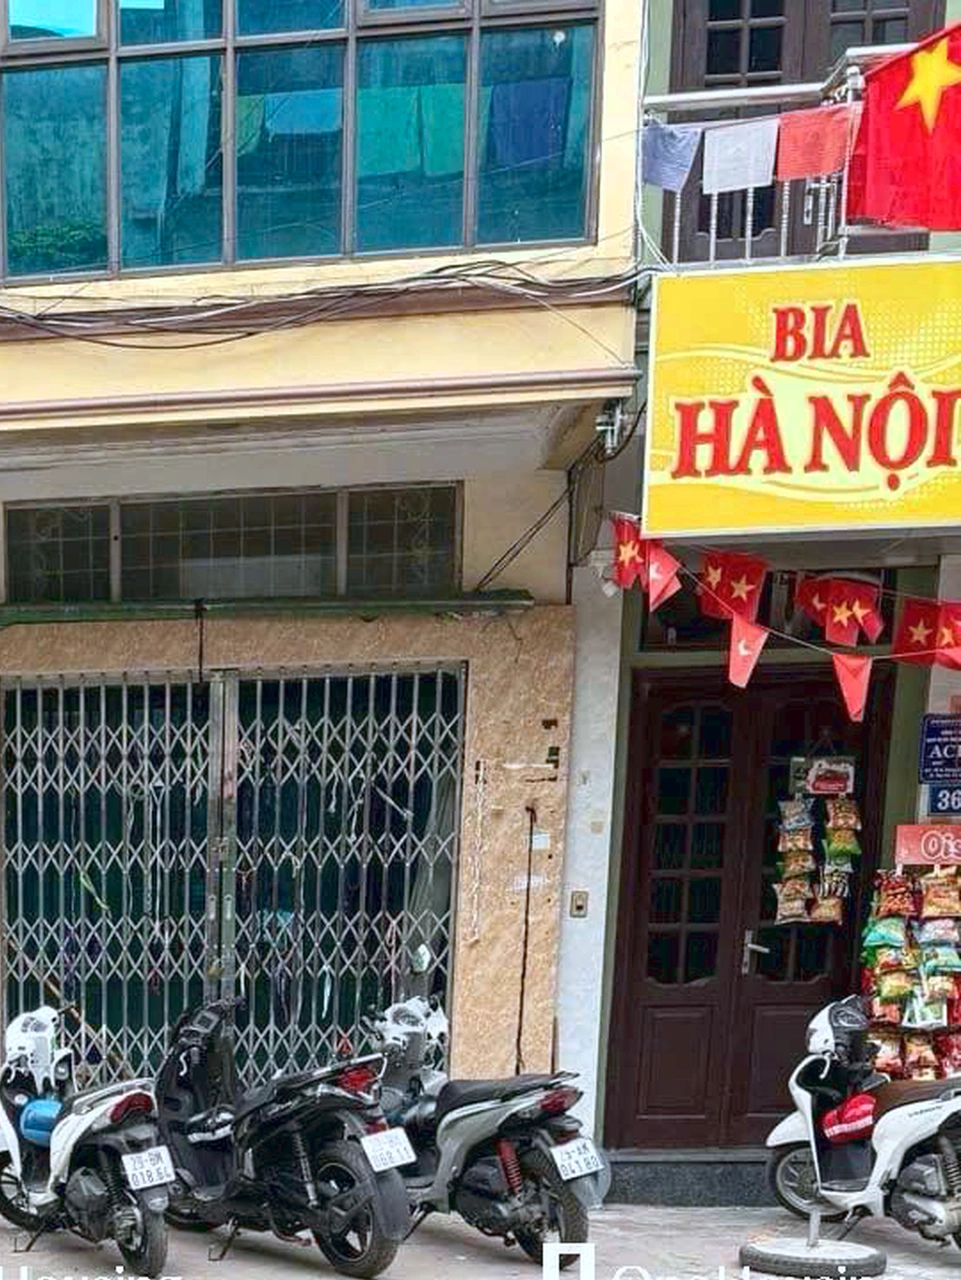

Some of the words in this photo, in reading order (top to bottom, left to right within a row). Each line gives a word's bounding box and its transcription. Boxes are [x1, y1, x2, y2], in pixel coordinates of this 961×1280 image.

[770, 303, 870, 363] BIA
[671, 375, 792, 479] HÀ
[804, 371, 961, 491] NỘI
